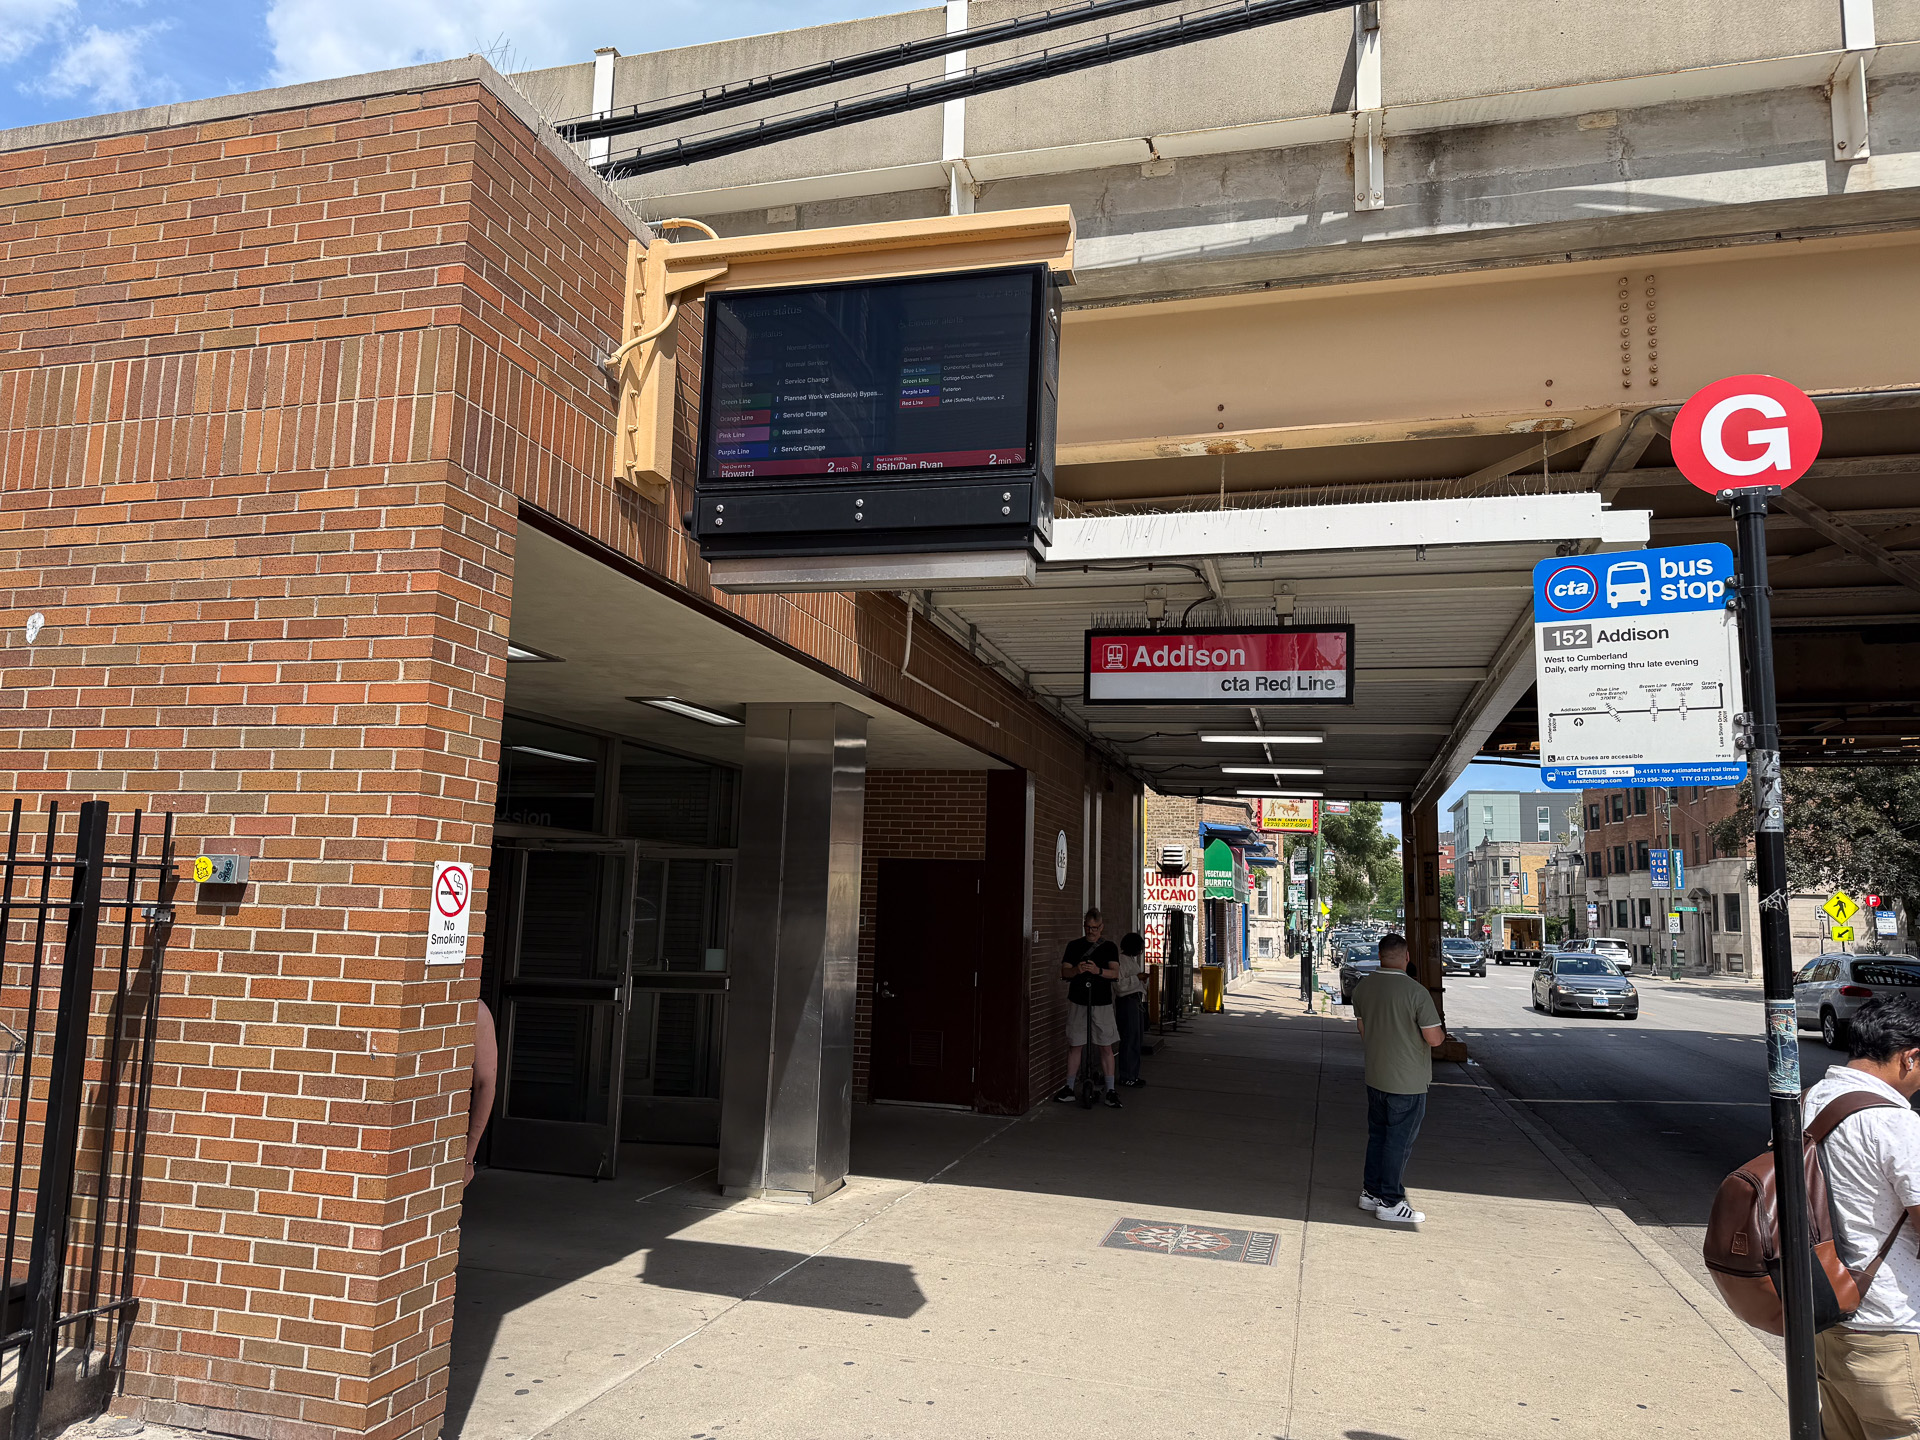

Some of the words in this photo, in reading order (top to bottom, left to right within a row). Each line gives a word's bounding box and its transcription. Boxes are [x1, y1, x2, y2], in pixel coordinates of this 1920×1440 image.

[736, 309, 771, 322] System
[773, 304, 803, 316] status
[785, 361, 806, 369] Normal
[807, 360, 830, 368] Service
[807, 376, 830, 384] Change
[783, 394, 807, 402] Planned
[808, 393, 823, 401] Work
[720, 415, 741, 423] Orange
[782, 411, 804, 419] Service
[805, 410, 828, 418] Change
[718, 431, 732, 439] Pink
[781, 428, 803, 436] Normal
[803, 427, 826, 435] Service
[1701, 393, 1792, 477] G
[717, 448, 737, 456] Purple
[737, 447, 750, 455] Line
[780, 445, 803, 453] Service
[803, 444, 826, 452] Change
[988, 453, 998, 466] 2
[998, 457, 1012, 465] min
[827, 461, 835, 473] 2
[835, 465, 849, 473] min
[876, 460, 918, 471] 95th/Dan
[721, 468, 755, 478] Howard
[1659, 557, 1714, 579] bus
[1553, 580, 1589, 598] cta
[1660, 579, 1726, 604] stop
[1551, 628, 1589, 647] 152
[1596, 627, 1670, 645] Addison
[1132, 644, 1246, 668] Addison
[1544, 655, 1565, 664] West
[1566, 654, 1576, 663] to
[1576, 651, 1628, 662] Cumberland
[1544, 665, 1567, 675] Daily,
[1568, 664, 1590, 673] early
[1590, 661, 1627, 672] morning
[1627, 660, 1646, 669] thru
[1647, 659, 1664, 668] late
[1664, 658, 1700, 668] evening
[1220, 676, 1250, 692] cta
[1255, 675, 1292, 692] Red
[1296, 674, 1336, 691] Line
[1565, 754, 1580, 762] CTA
[1580, 754, 1599, 762] buses
[1610, 752, 1644, 761] accessible
[1577, 768, 1607, 777] CTABUS
[1567, 778, 1623, 787] transitchicago.com
[1204, 870, 1233, 878] VEGETARIAN
[1204, 878, 1233, 887] BURRITO
[1869, 896, 1877, 906] F
[1143, 903, 1162, 911] BEST
[444, 920, 456, 931] No
[430, 933, 466, 947] Smoking
[1245, 1232, 1274, 1264] ADDISON
